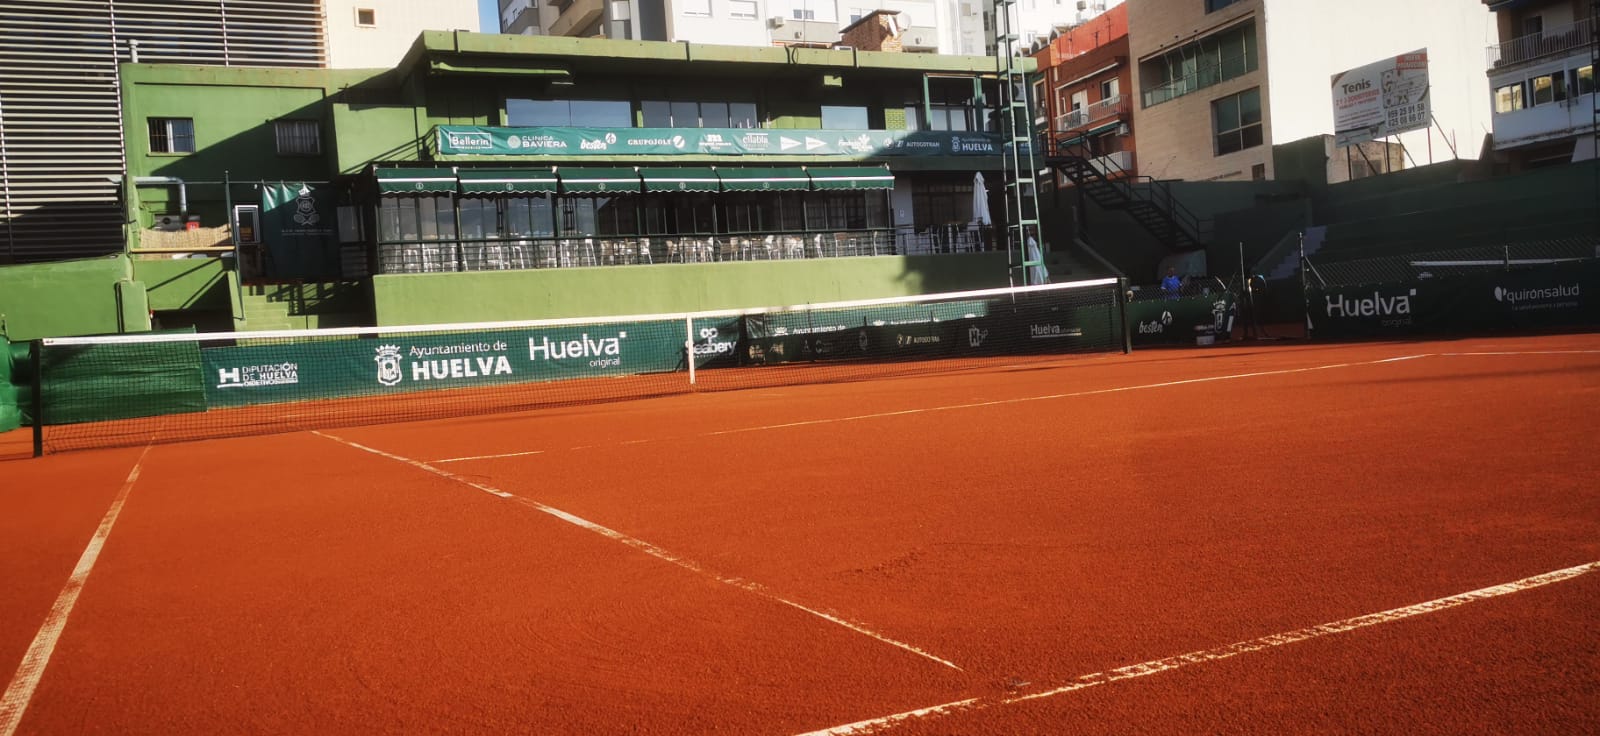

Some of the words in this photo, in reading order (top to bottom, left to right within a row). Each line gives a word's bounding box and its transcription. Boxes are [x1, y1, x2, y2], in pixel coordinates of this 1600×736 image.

[1342, 78, 1371, 95] Tenis
[962, 143, 993, 151] HUELVA
[1506, 283, 1580, 304] quirónsalud
[1325, 291, 1410, 317] Huelva
[1030, 323, 1060, 336] Huelva
[409, 343, 490, 358] Ayuntamiento
[493, 340, 507, 351] de
[528, 333, 620, 361] Huelva
[411, 355, 513, 381] HUELVA
[589, 357, 620, 368] original
[242, 373, 256, 381] DE
[259, 370, 298, 381] HUELVA
